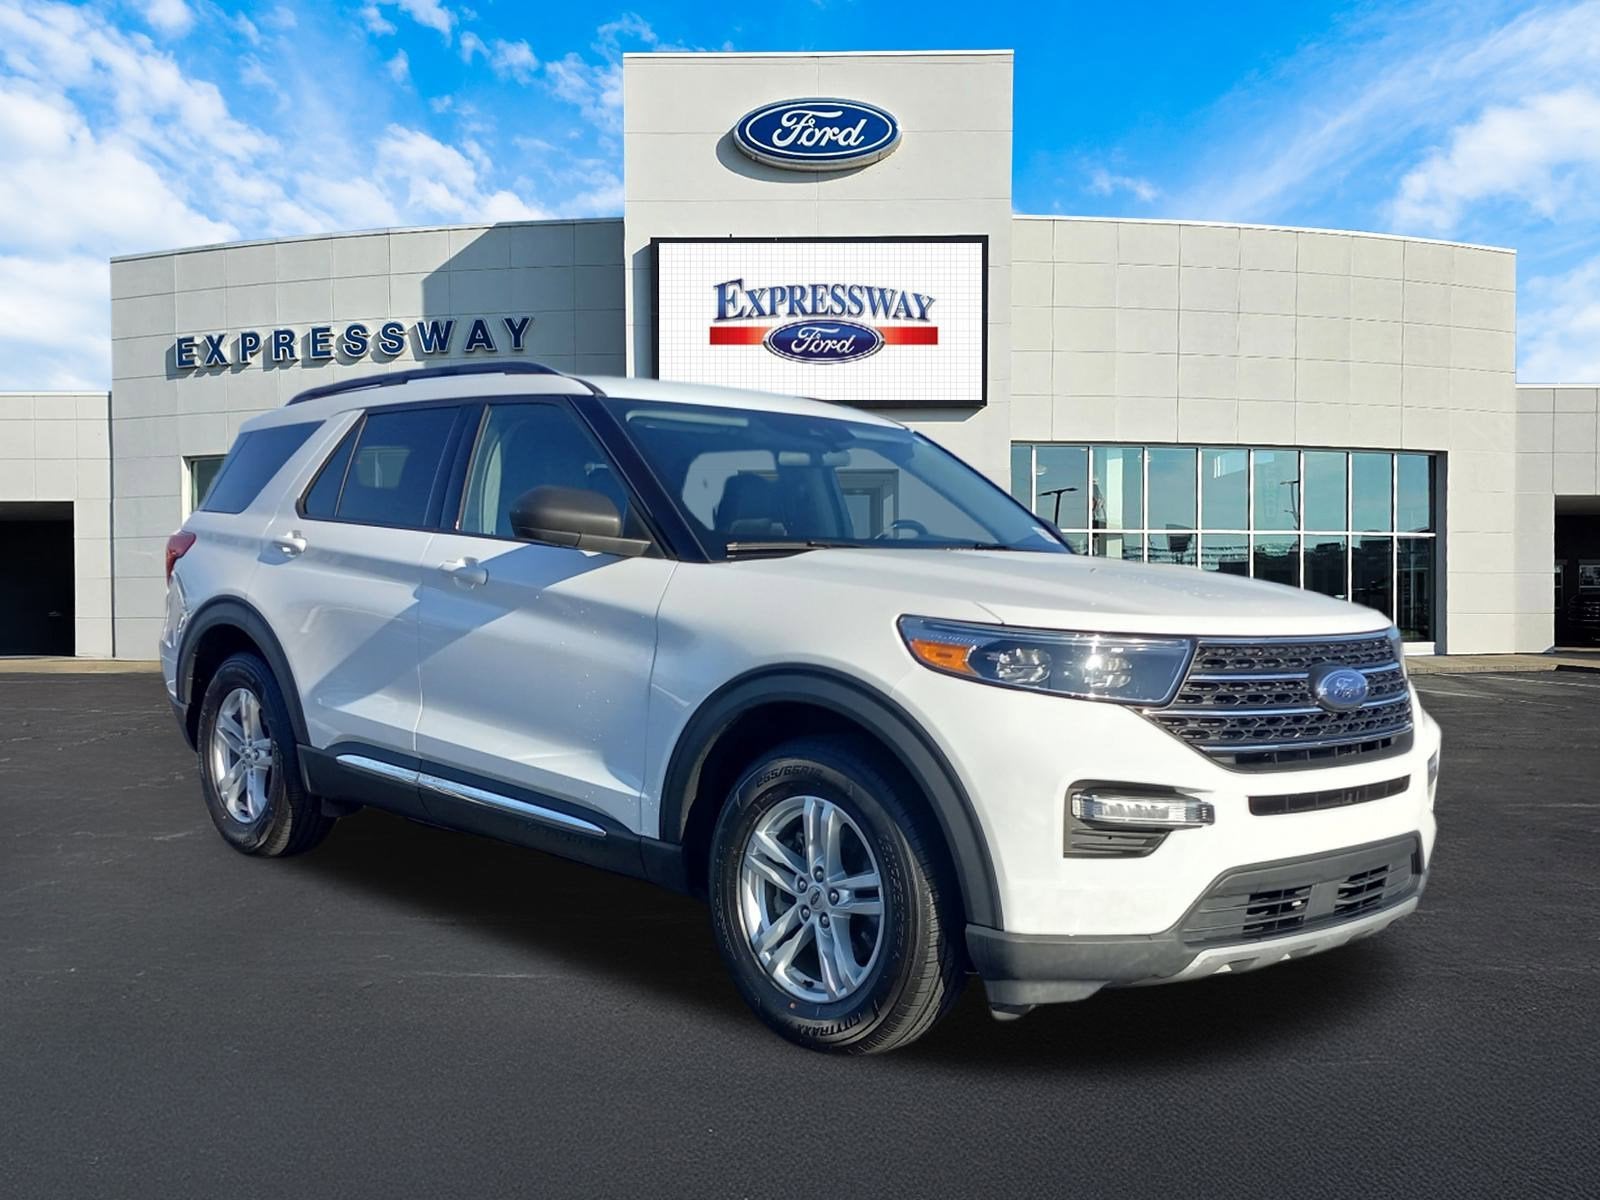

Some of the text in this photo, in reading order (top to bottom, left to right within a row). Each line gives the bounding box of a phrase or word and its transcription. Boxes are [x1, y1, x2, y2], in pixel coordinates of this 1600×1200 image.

[771, 109, 865, 148] Ford
[712, 278, 936, 323] EXPRESSWAY
[175, 317, 531, 369] EXPRESSWAY
[790, 326, 856, 356] Ford
